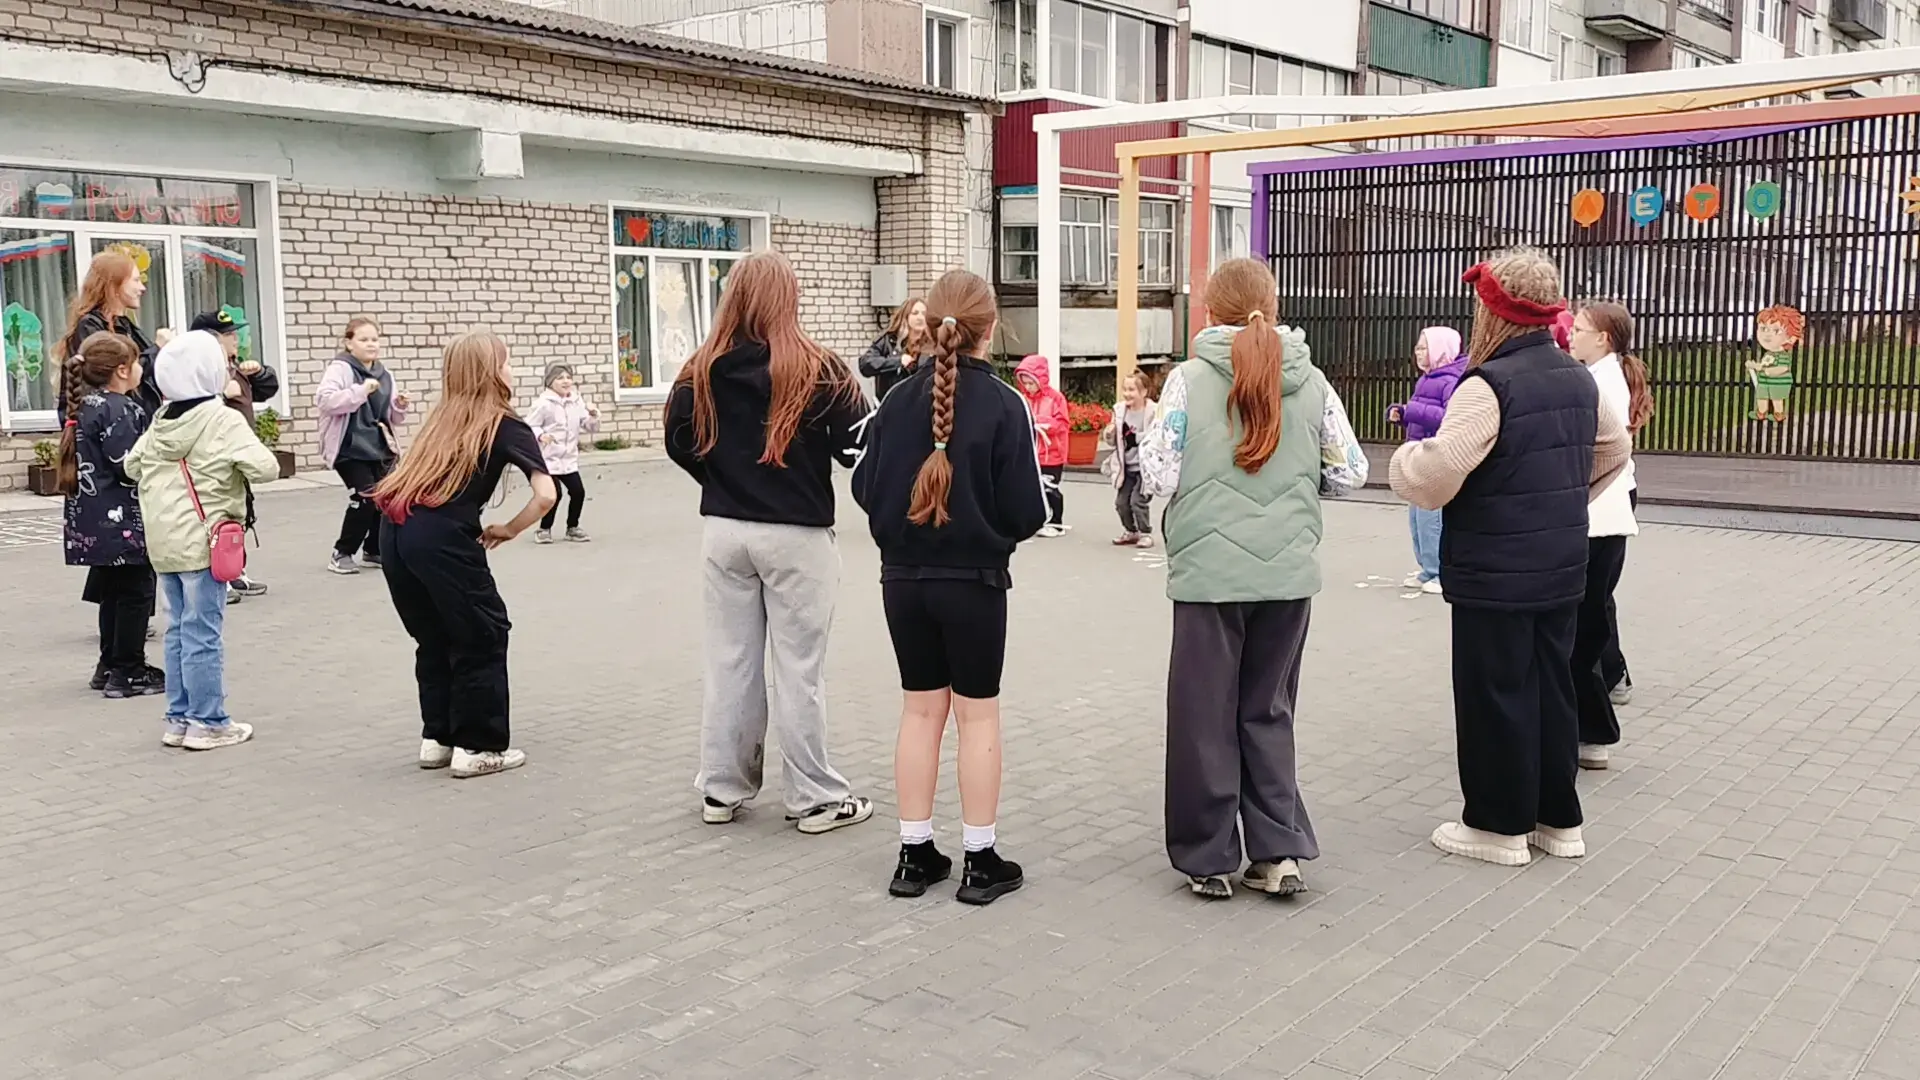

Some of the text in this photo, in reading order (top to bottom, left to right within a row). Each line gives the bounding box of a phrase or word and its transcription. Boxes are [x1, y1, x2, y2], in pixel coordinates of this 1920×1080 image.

[0, 179, 241, 225] Я РОССИЮ
[1577, 188, 1774, 217] ЛЕТО
